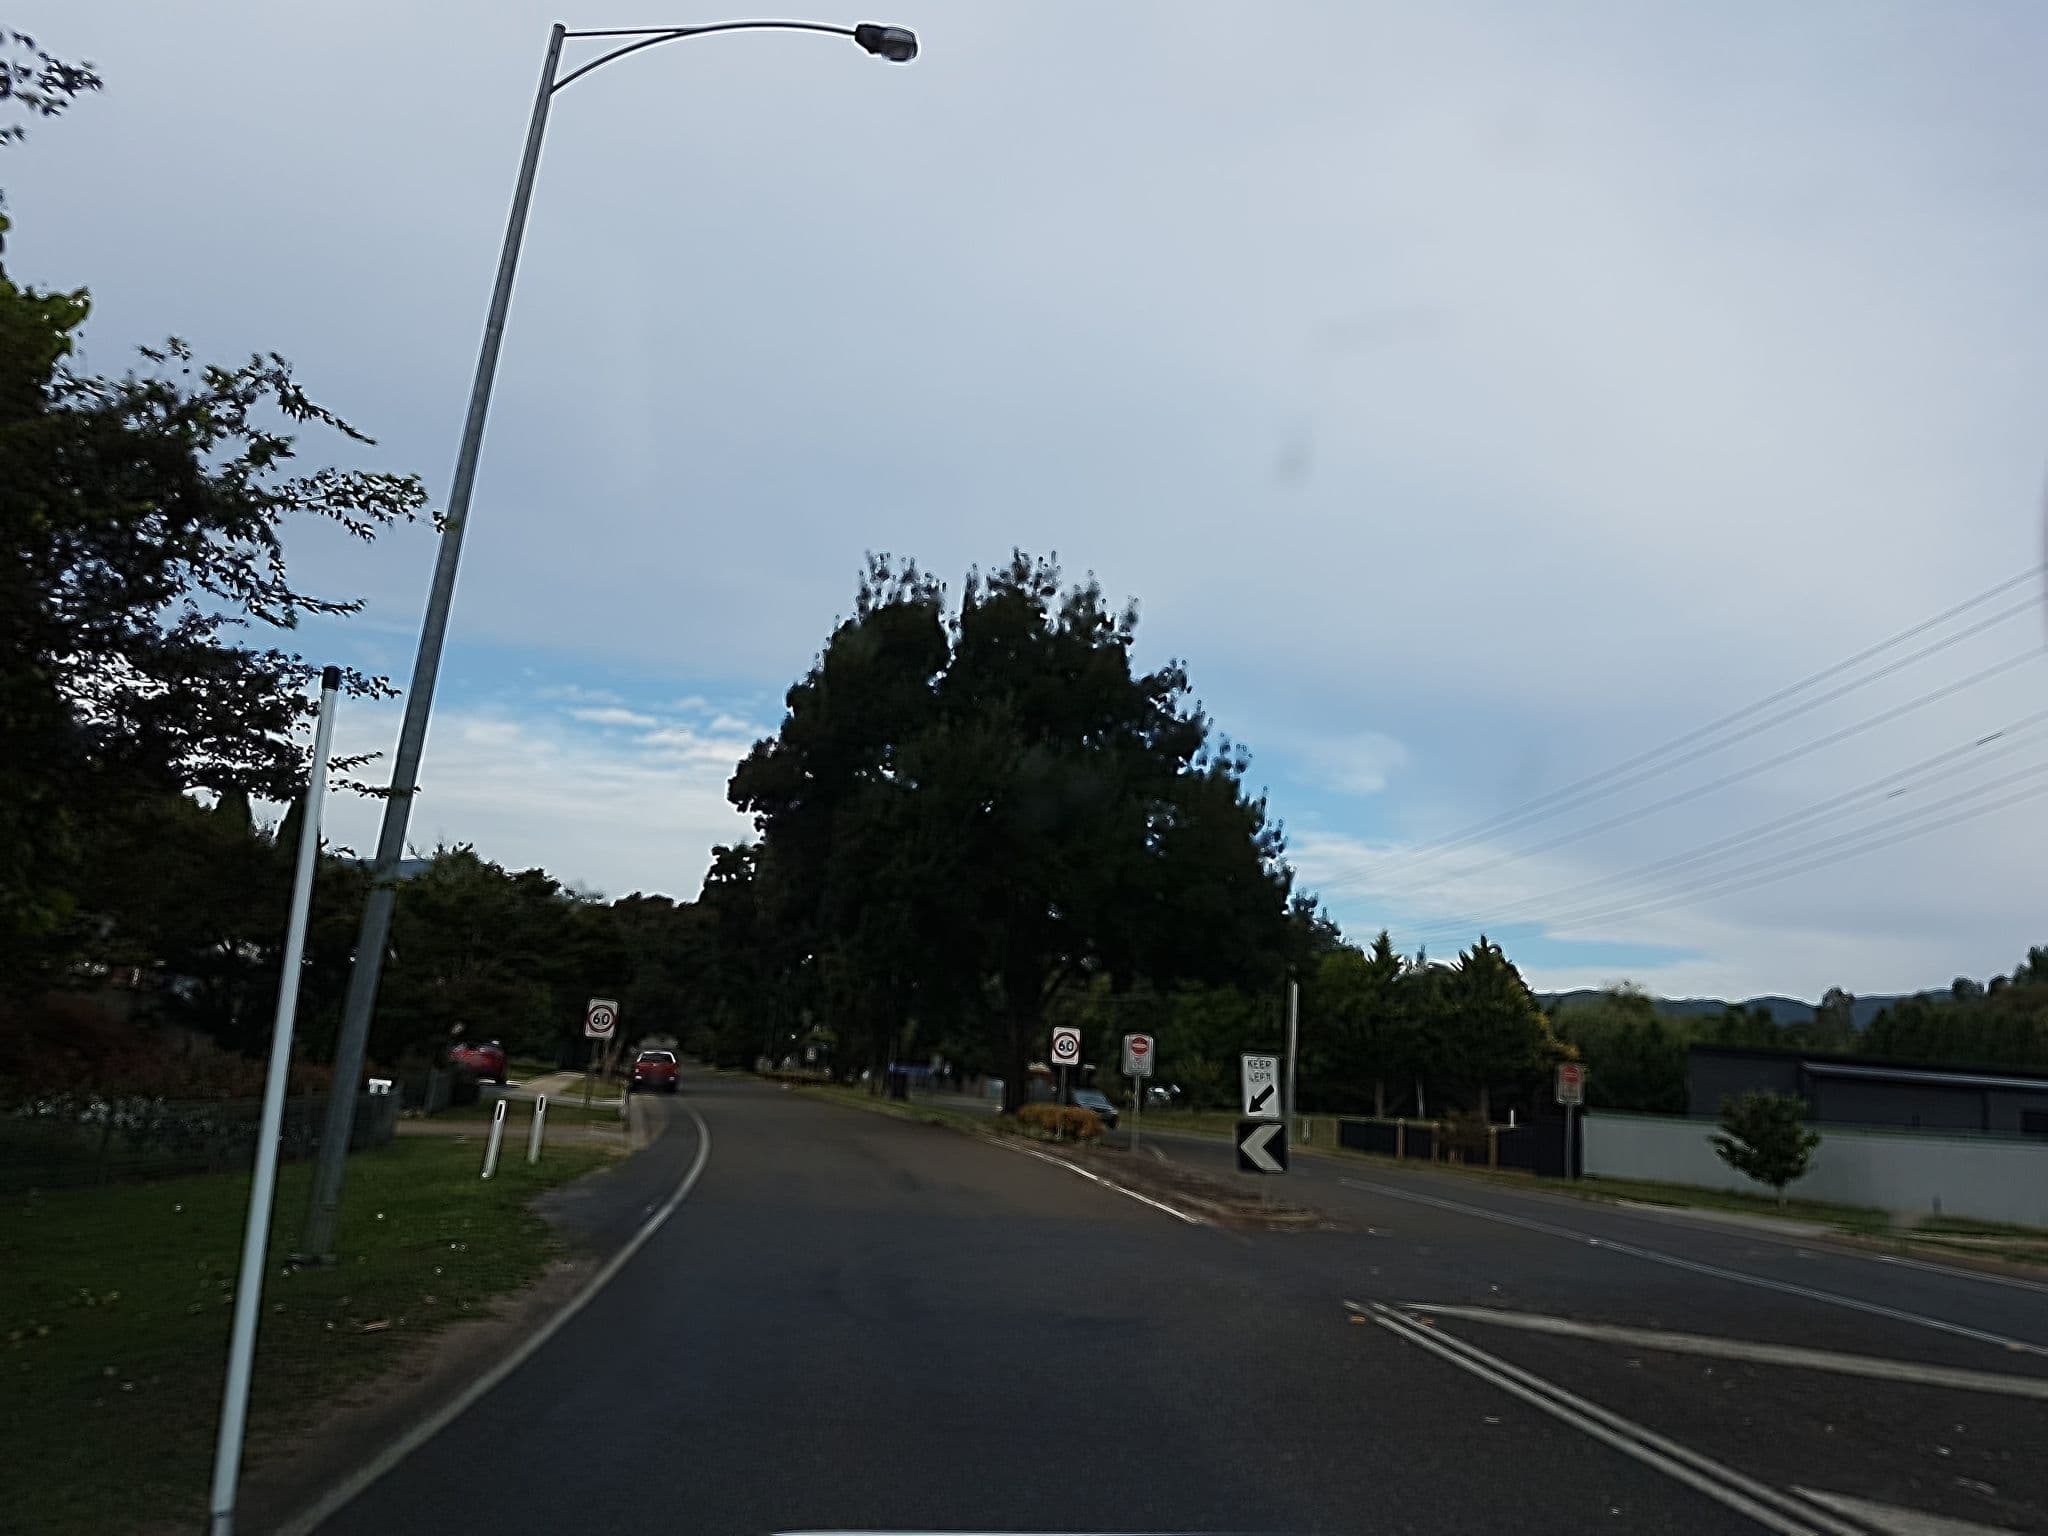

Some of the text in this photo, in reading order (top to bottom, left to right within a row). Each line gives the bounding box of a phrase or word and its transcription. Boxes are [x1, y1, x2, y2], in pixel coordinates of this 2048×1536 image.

[593, 1012, 610, 1025] 60
[1059, 1040, 1074, 1052] 60
[1247, 1060, 1271, 1069] KEEP
